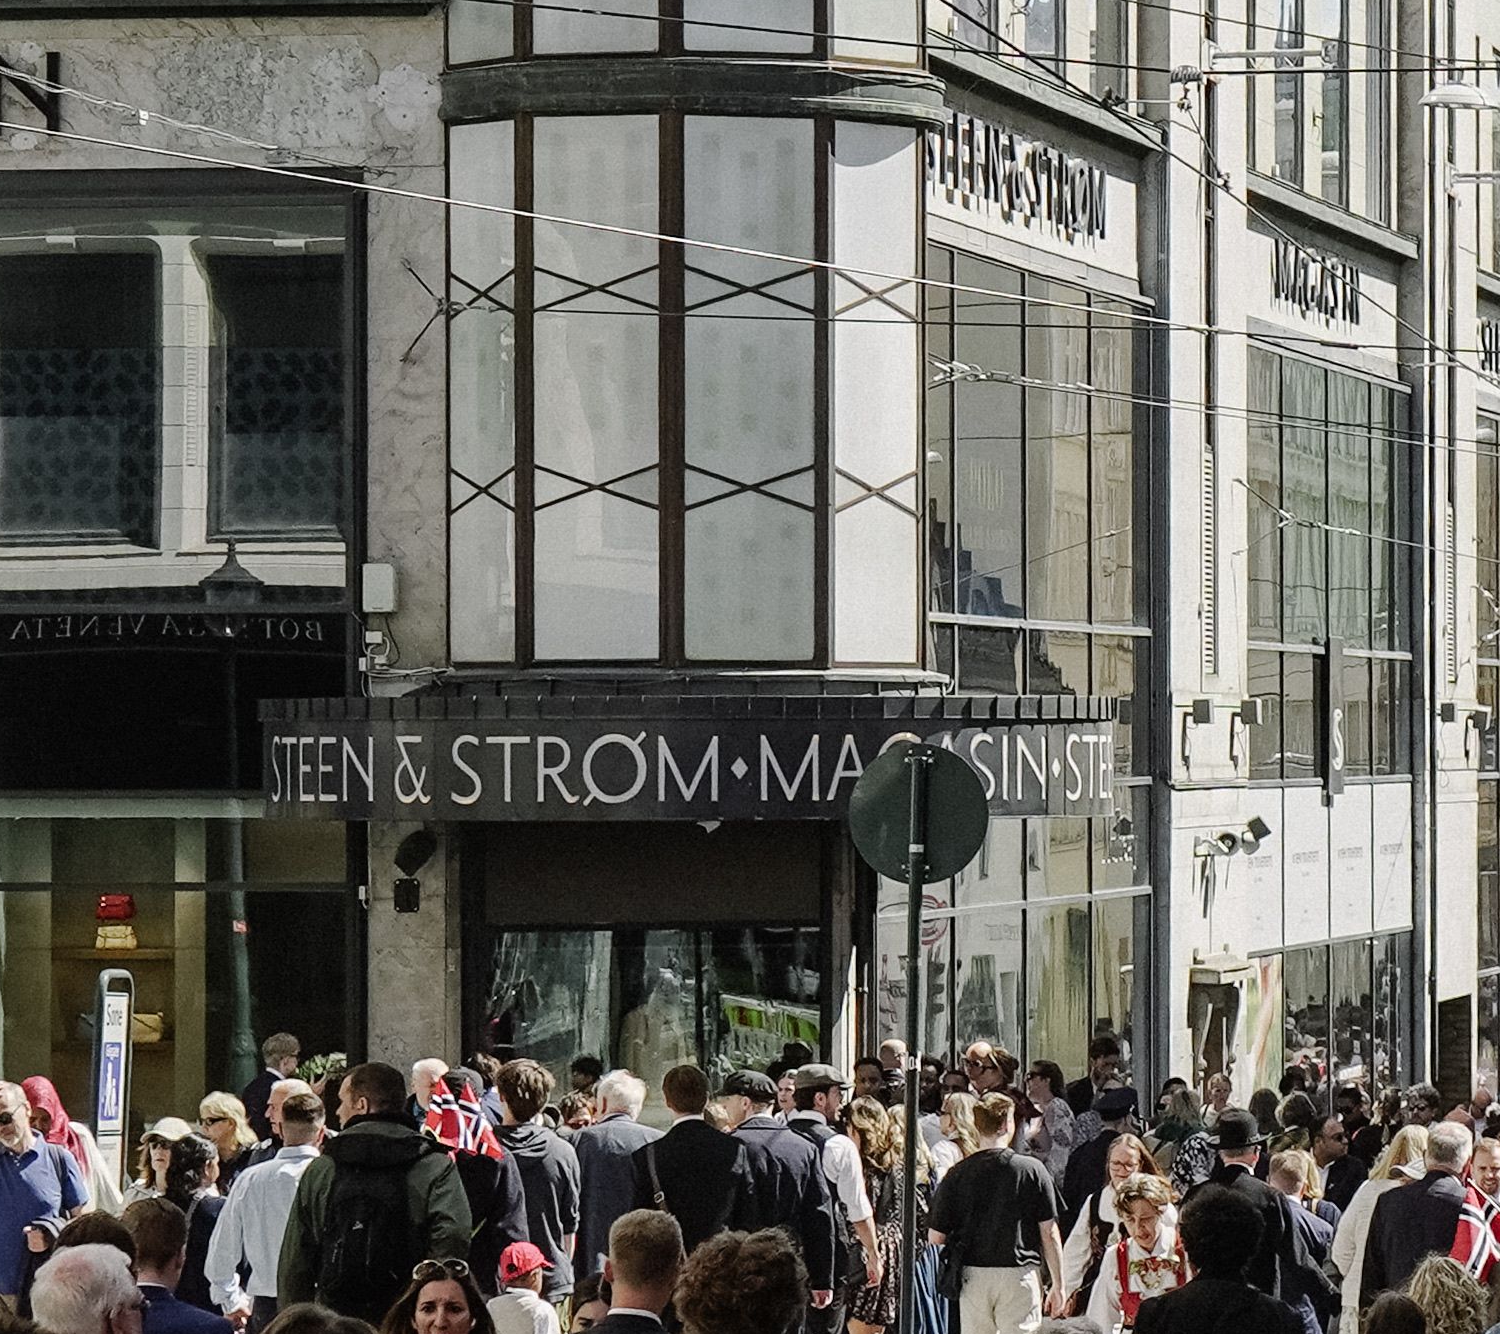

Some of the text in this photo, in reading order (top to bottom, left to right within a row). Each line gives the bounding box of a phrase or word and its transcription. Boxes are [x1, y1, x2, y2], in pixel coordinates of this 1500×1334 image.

[270, 734, 375, 803] STEEN
[393, 735, 432, 805] &
[451, 730, 719, 807] STRØM
[759, 733, 1047, 802] MASIN
